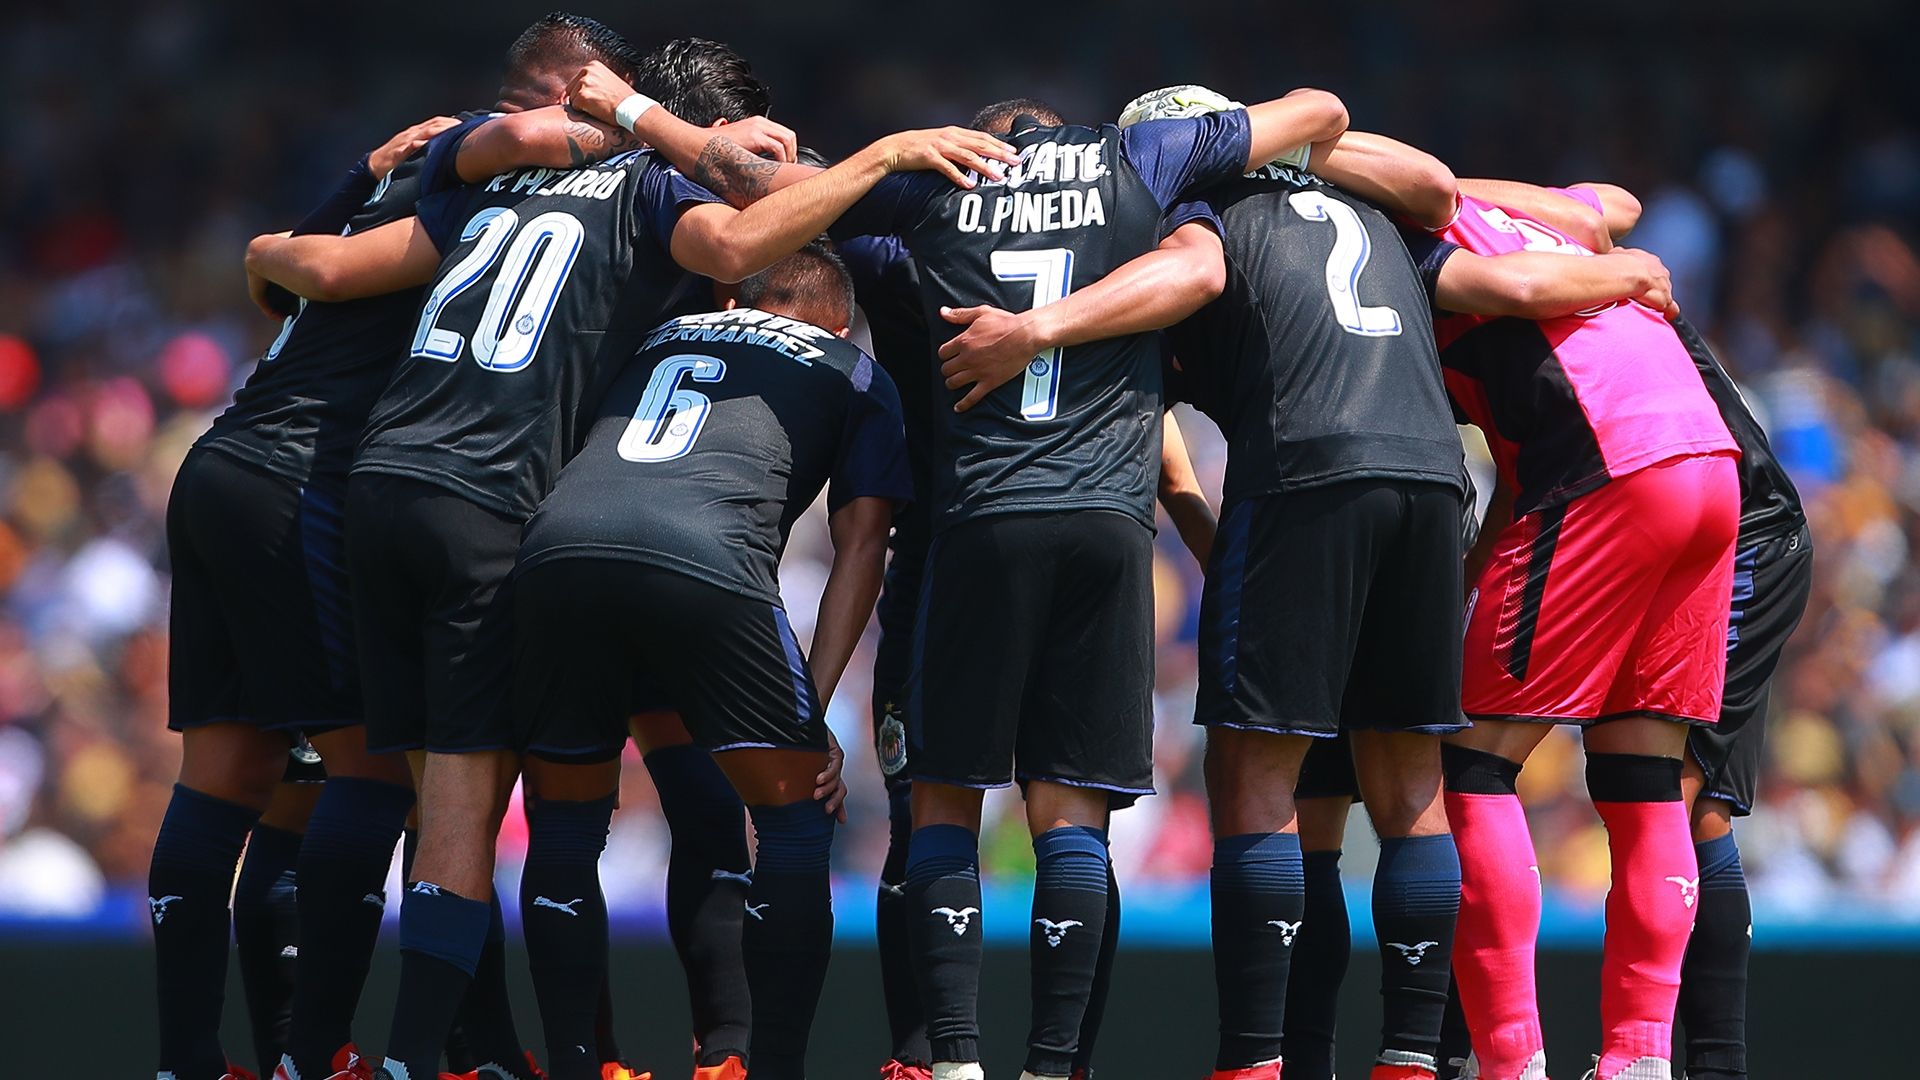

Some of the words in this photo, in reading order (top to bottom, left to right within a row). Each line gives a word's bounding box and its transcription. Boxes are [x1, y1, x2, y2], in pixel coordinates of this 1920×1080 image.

[957, 193, 987, 233] O.
[991, 187, 1106, 233] PINEDA
[1288, 190, 1403, 336] 2
[411, 206, 585, 373] 20
[634, 324, 826, 368] HERNANDEZ
[990, 248, 1075, 422] 7
[617, 354, 727, 463] 6
